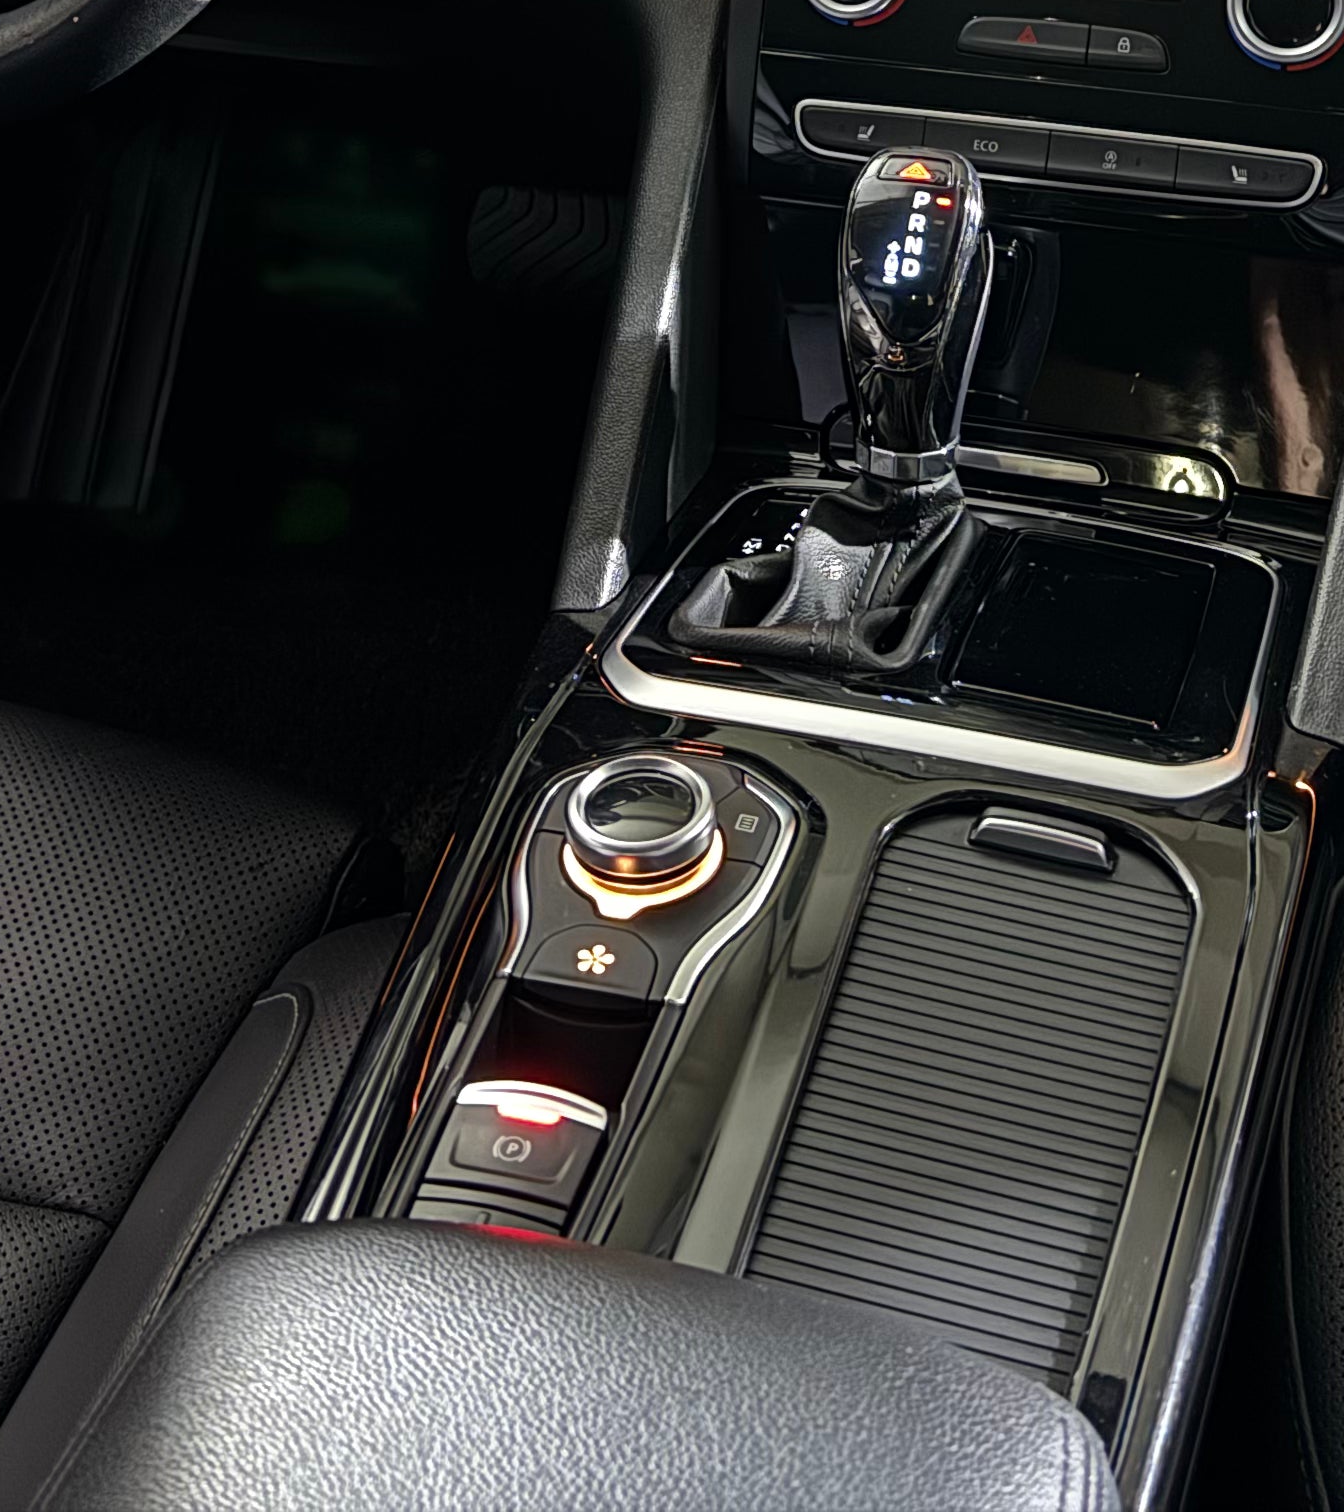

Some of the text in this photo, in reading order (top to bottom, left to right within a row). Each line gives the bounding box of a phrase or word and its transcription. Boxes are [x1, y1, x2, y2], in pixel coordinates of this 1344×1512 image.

[973, 139, 999, 153] ECO
[1102, 162, 1117, 170] OFF
[912, 190, 931, 209] P
[907, 212, 926, 233] R
[903, 235, 924, 256] N
[901, 257, 920, 278] D
